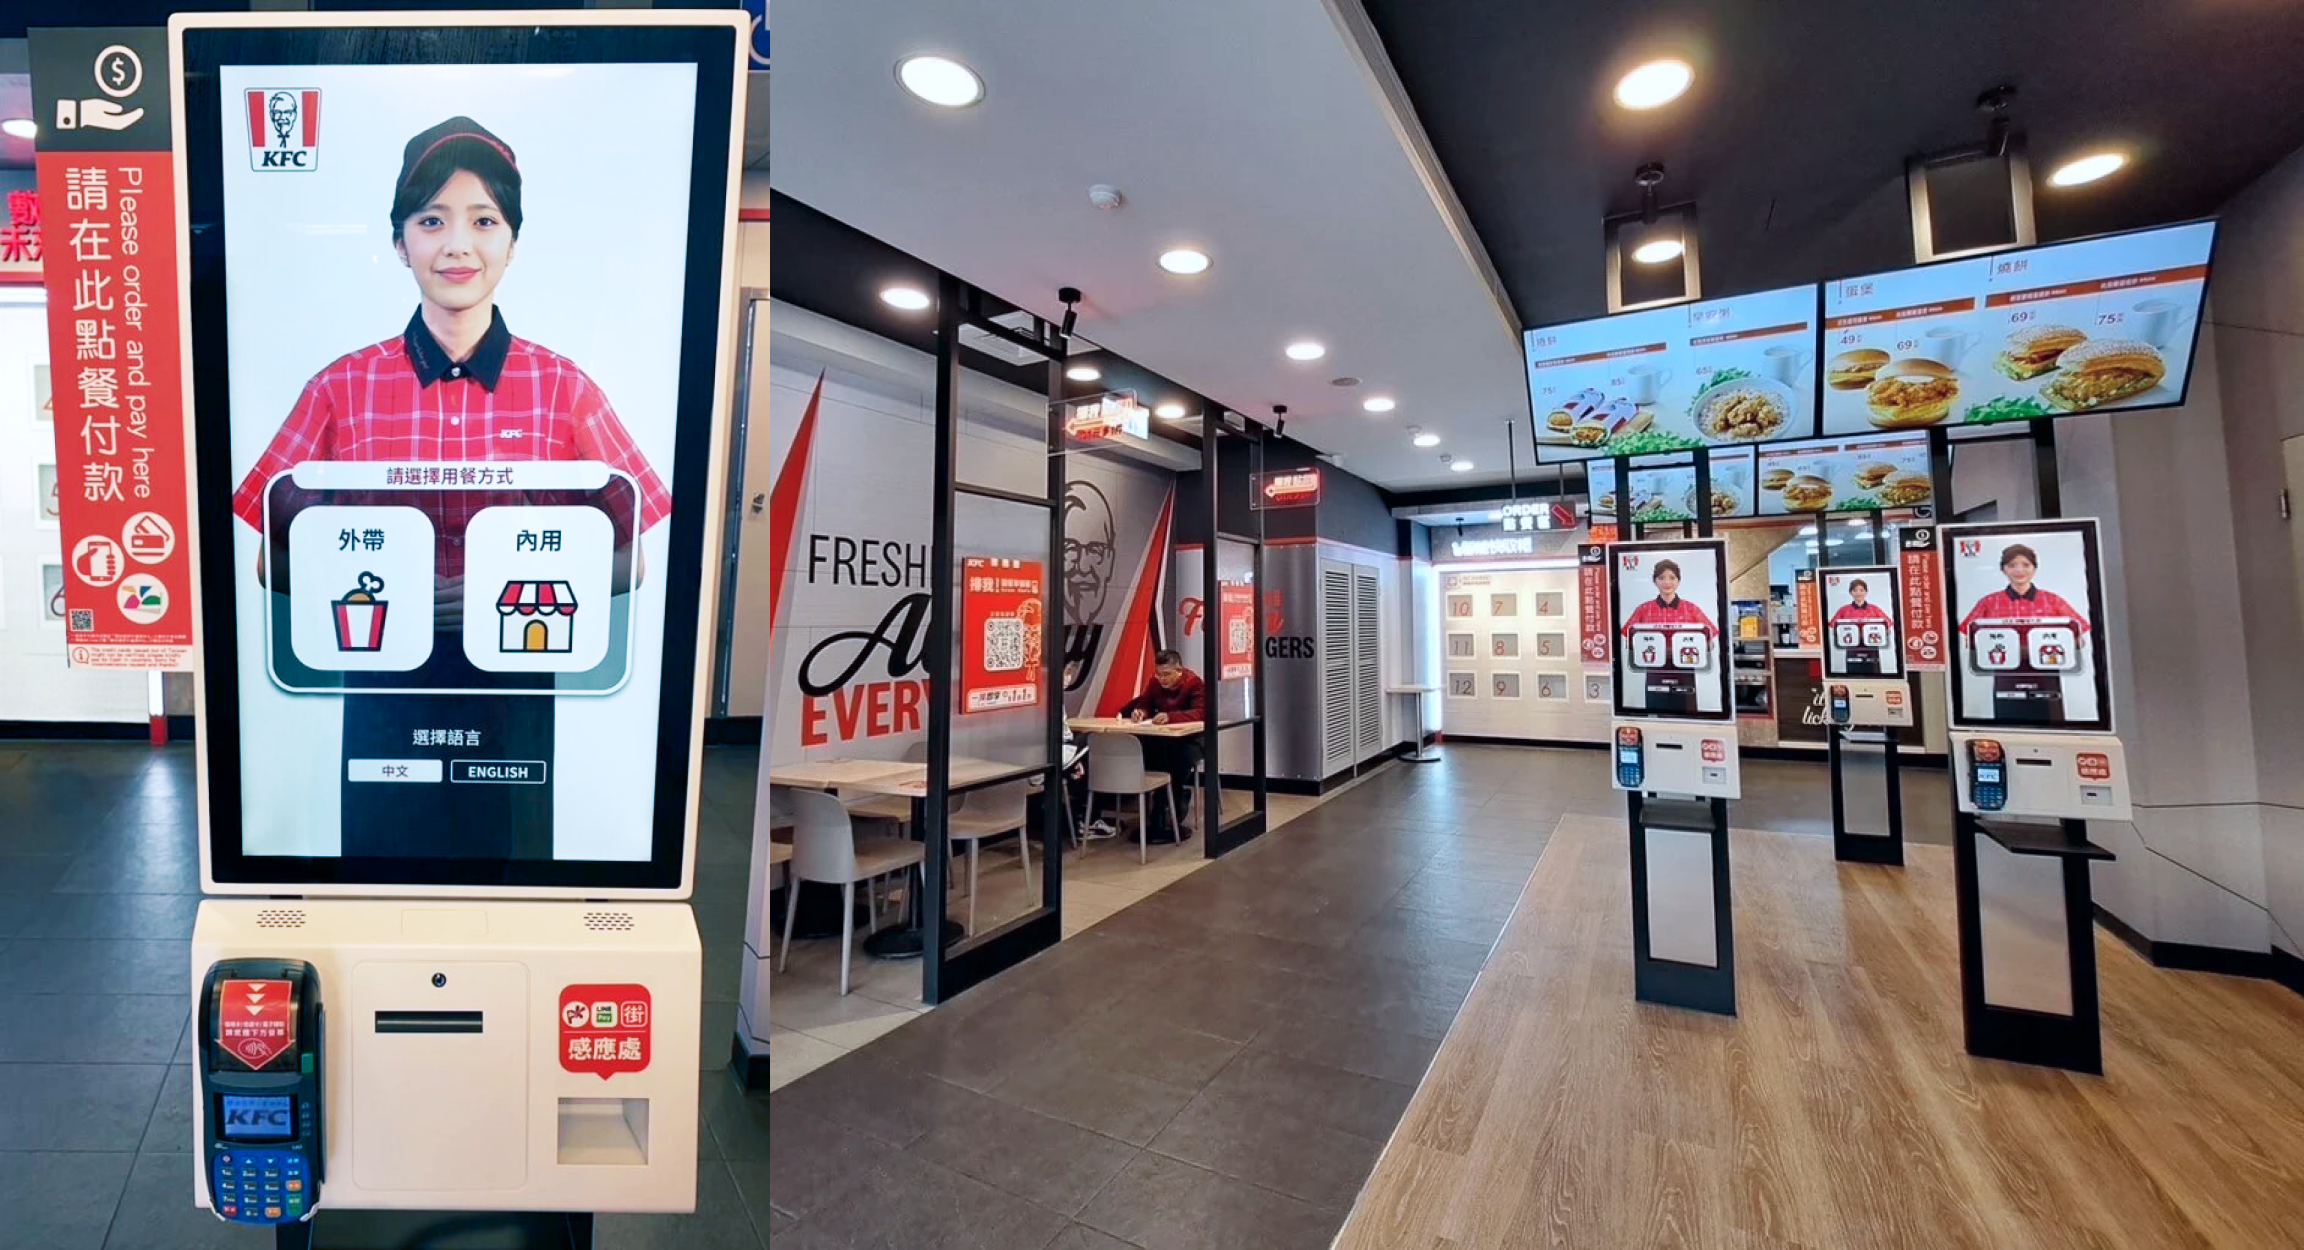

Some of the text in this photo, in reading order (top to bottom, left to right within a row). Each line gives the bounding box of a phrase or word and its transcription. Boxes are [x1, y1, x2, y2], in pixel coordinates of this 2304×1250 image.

[262, 151, 307, 167] KFC
[65, 167, 125, 502] 請在此點餐付款
[119, 167, 154, 499] Please order and pay here
[386, 467, 514, 486] 請選擇用餐方式
[338, 528, 385, 552] 外帶
[516, 529, 562, 552] 內用
[808, 534, 933, 588] FRESH
[1453, 602, 1470, 615] 10
[1494, 601, 1503, 612] 7
[1540, 601, 1549, 613] 4
[1455, 641, 1469, 654] 11
[1494, 641, 1504, 656] 8
[1541, 640, 1550, 655] 5
[1455, 680, 1471, 695] 12
[1496, 681, 1506, 695] 9
[1542, 683, 1551, 697] 6
[1590, 684, 1599, 698] 3
[801, 678, 931, 746] EVER
[412, 729, 481, 747] 選擇語言
[382, 765, 529, 779] 中文 ENGLISH
[624, 1005, 645, 1024] 街
[568, 1037, 641, 1060] 感應處
[227, 1109, 287, 1126] KFC
